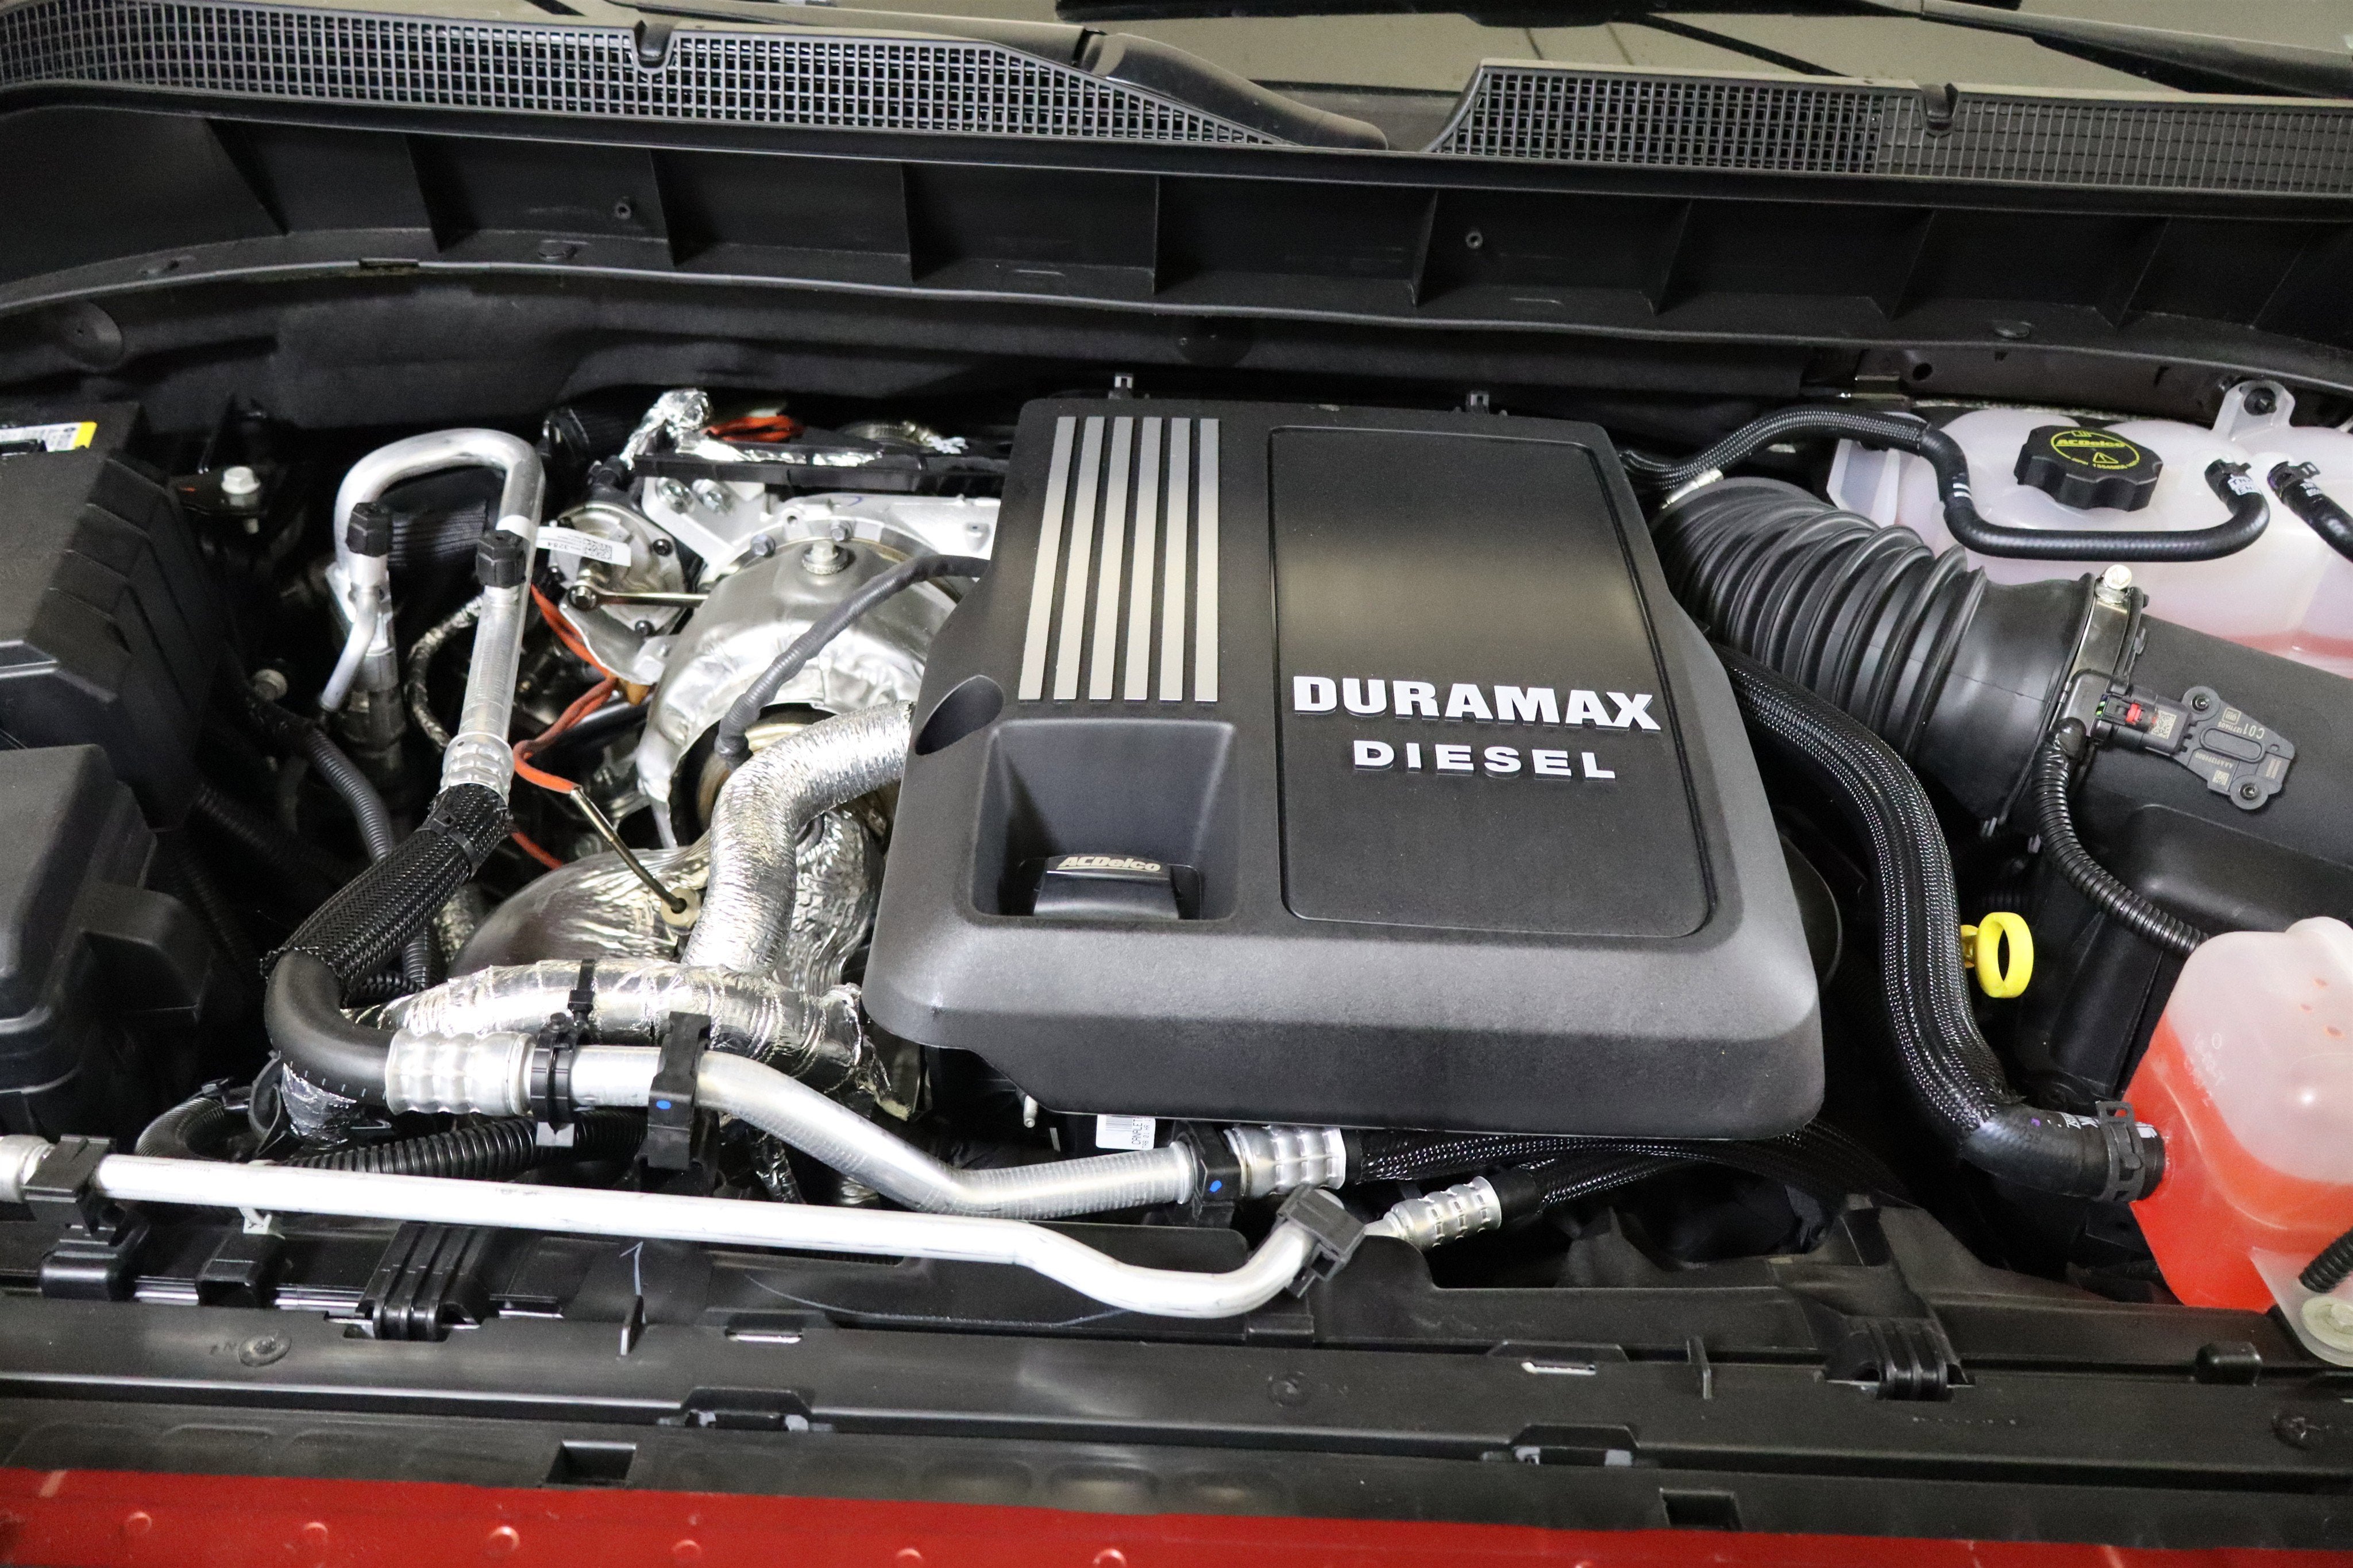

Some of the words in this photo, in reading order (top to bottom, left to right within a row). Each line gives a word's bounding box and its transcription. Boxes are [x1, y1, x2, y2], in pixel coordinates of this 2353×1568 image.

[2057, 439, 2126, 447] ACDelco
[1293, 675, 1661, 732] DURAMAX
[2242, 723, 2265, 740] C01
[1353, 740, 1615, 782] DIESEL
[1057, 856, 1161, 872] ACDelco
[1131, 1117, 1143, 1145] CANALET
